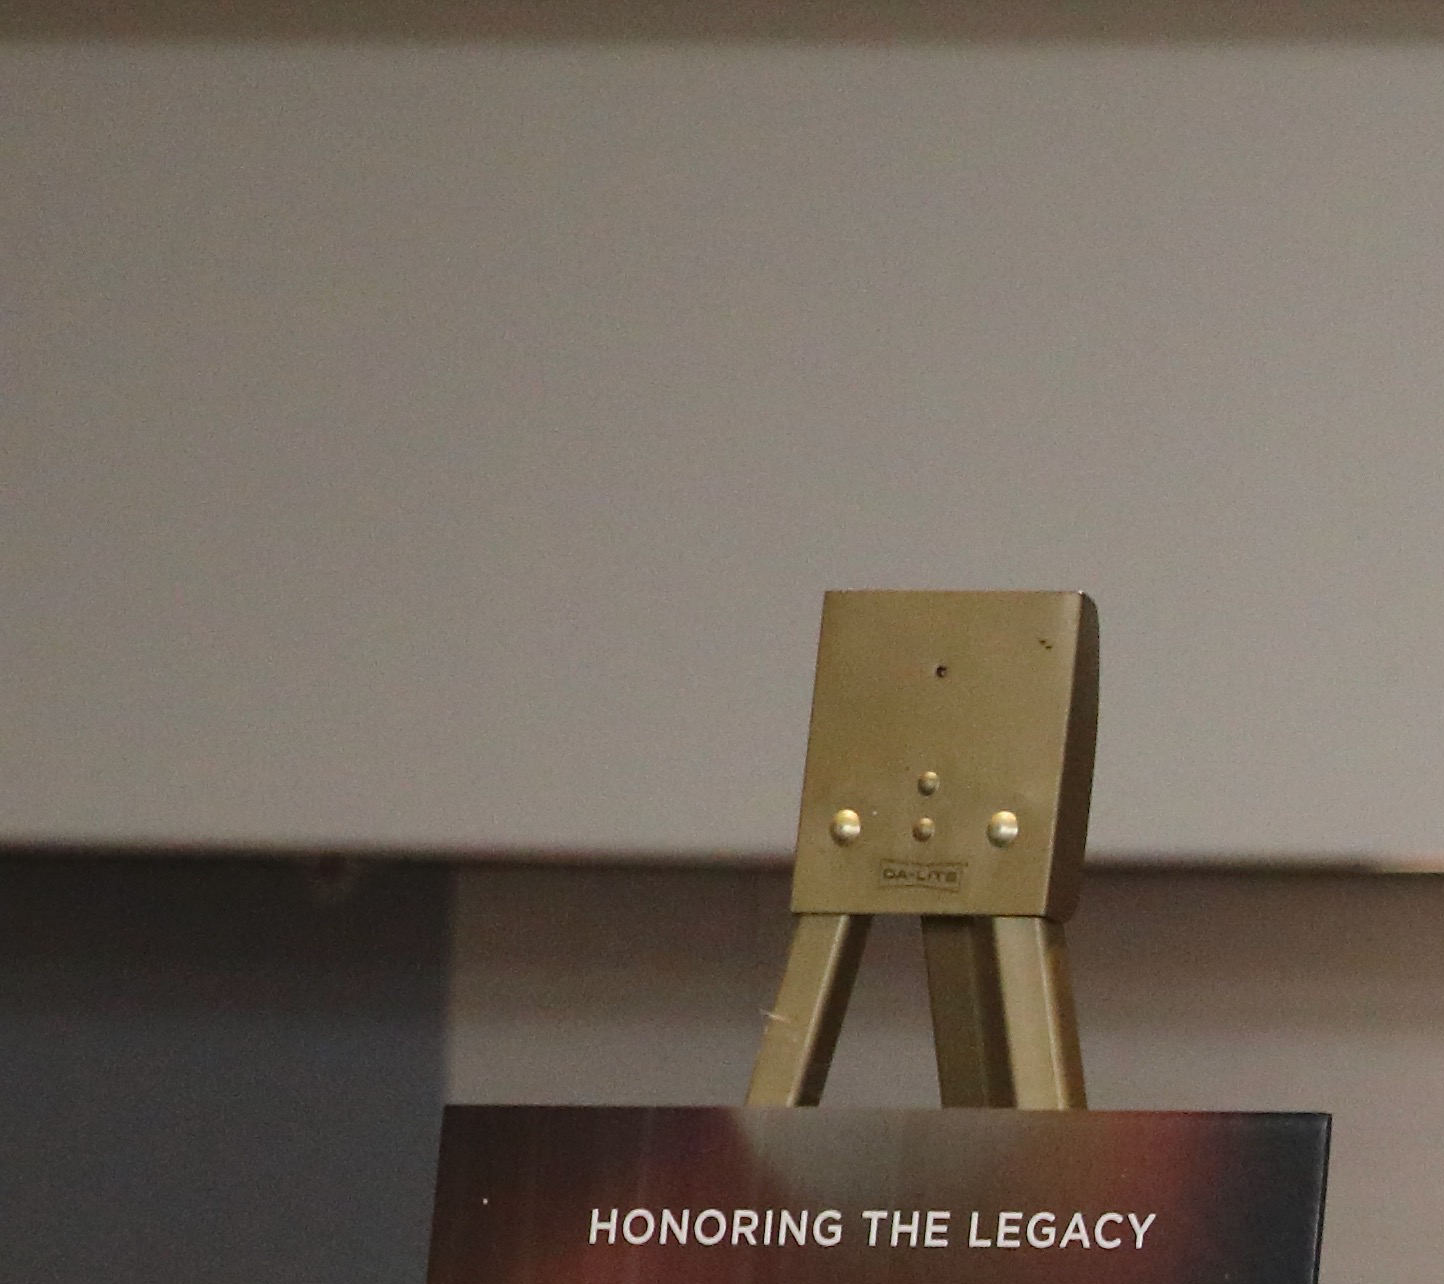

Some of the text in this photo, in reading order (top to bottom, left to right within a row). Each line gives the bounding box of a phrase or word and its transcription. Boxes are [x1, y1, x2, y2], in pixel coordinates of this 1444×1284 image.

[589, 1208, 1157, 1250] HONORING THE LEGACY
